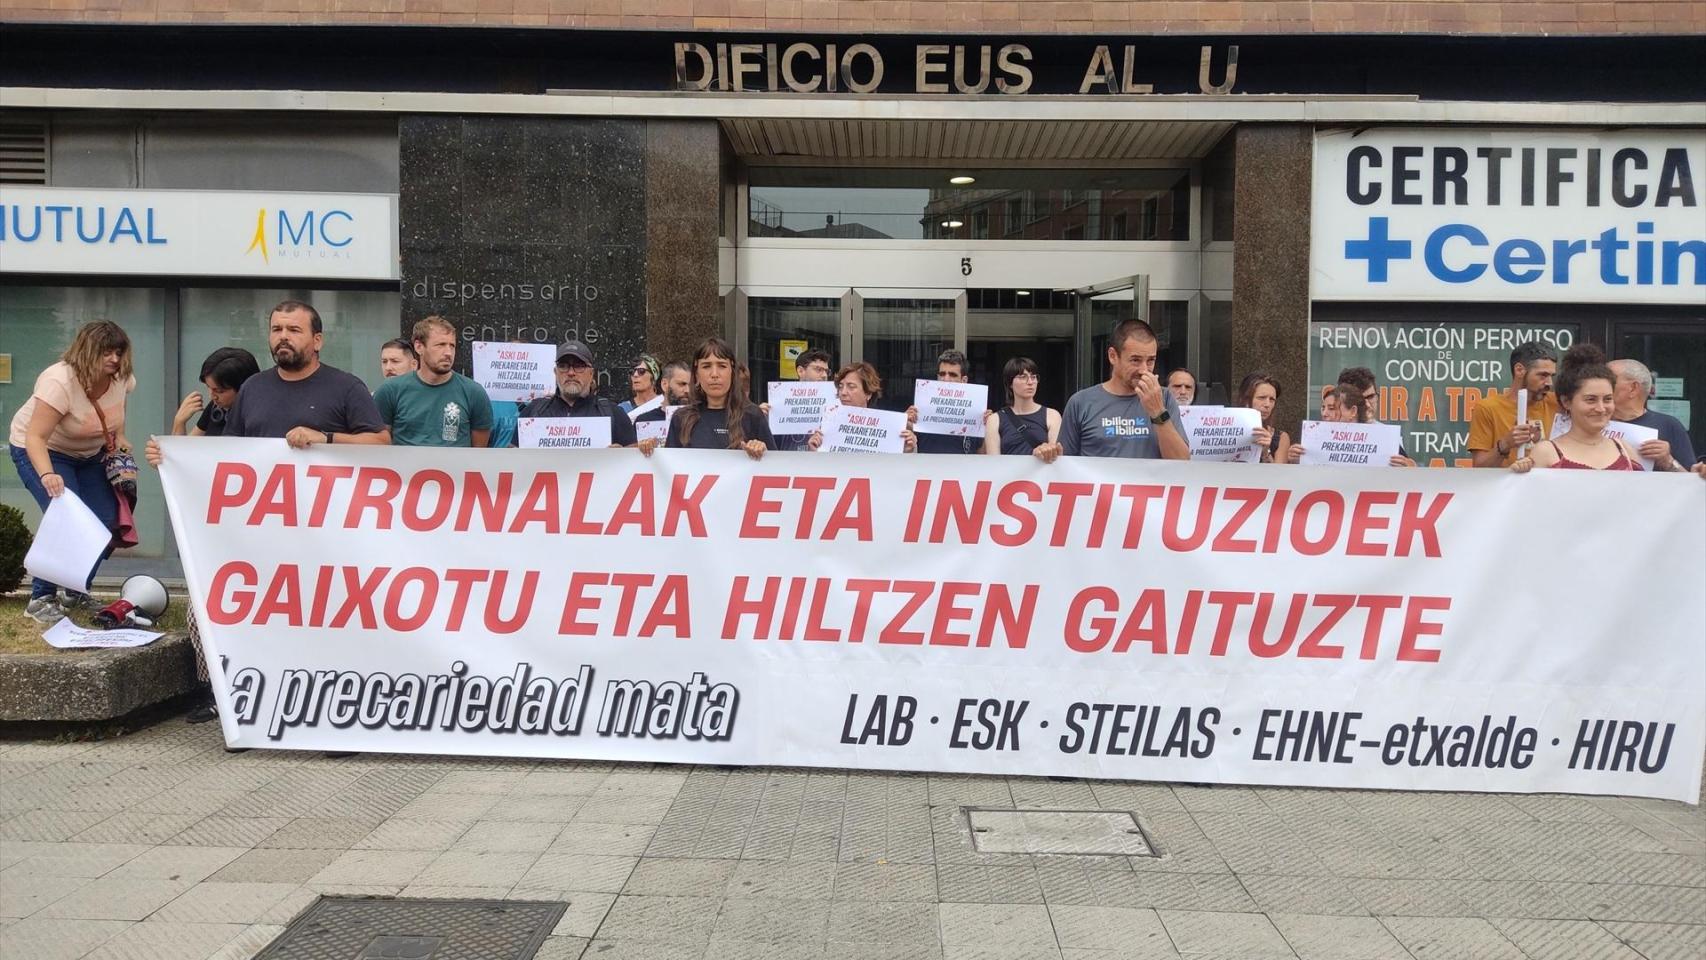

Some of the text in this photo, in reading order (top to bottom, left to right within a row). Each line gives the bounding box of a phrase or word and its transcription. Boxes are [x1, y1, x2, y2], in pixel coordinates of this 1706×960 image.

[674, 42, 884, 93] DIFICIO
[1198, 45, 1239, 94] U
[1346, 145, 1697, 208] CERTIFICA
[278, 209, 353, 248] MC
[278, 249, 352, 258] MUTUAL
[960, 257, 973, 277] 5
[413, 276, 599, 306] dispensario
[462, 320, 600, 344] entro de
[1474, 328, 1573, 351] PERMISO
[516, 351, 529, 361] DA!
[1437, 350, 1452, 360] DE
[490, 360, 538, 371] PREKARIETATEA
[1385, 359, 1503, 382] CONDUCIR
[497, 371, 531, 381] HILTZAILEA
[484, 381, 492, 389] LA
[530, 383, 545, 391] MATA
[807, 389, 818, 398] DA!
[930, 397, 972, 408] PREKARIETATEA
[1417, 385, 1438, 422] A
[790, 406, 821, 415] HILTZAILEA
[935, 407, 966, 417] HILTZAILEA
[866, 415, 880, 426] DA!
[1220, 416, 1235, 426] DA!
[567, 426, 581, 437] DA!
[838, 423, 888, 439] PREKARIETATEA
[1193, 427, 1244, 437] PREKARIETATEA
[1352, 431, 1368, 443] DA!
[538, 437, 591, 448] PREKARIETATEA
[843, 435, 880, 449] HILTZAILEA
[1200, 437, 1238, 447] HILTZAILEA
[1321, 442, 1378, 454] PREKARIETATEA
[1328, 453, 1369, 465] HILTZAILEA
[206, 461, 1454, 559] PATRONALAK ETA INSTITUZIOEK
[206, 560, 1451, 663] GAIXOTU ETA HILTZEN GAITUZTE
[267, 660, 595, 741] precariedad
[597, 671, 740, 742] mata
[840, 693, 1676, 774] LAB ESK STEILAS EHNE-etxalde HIRU
